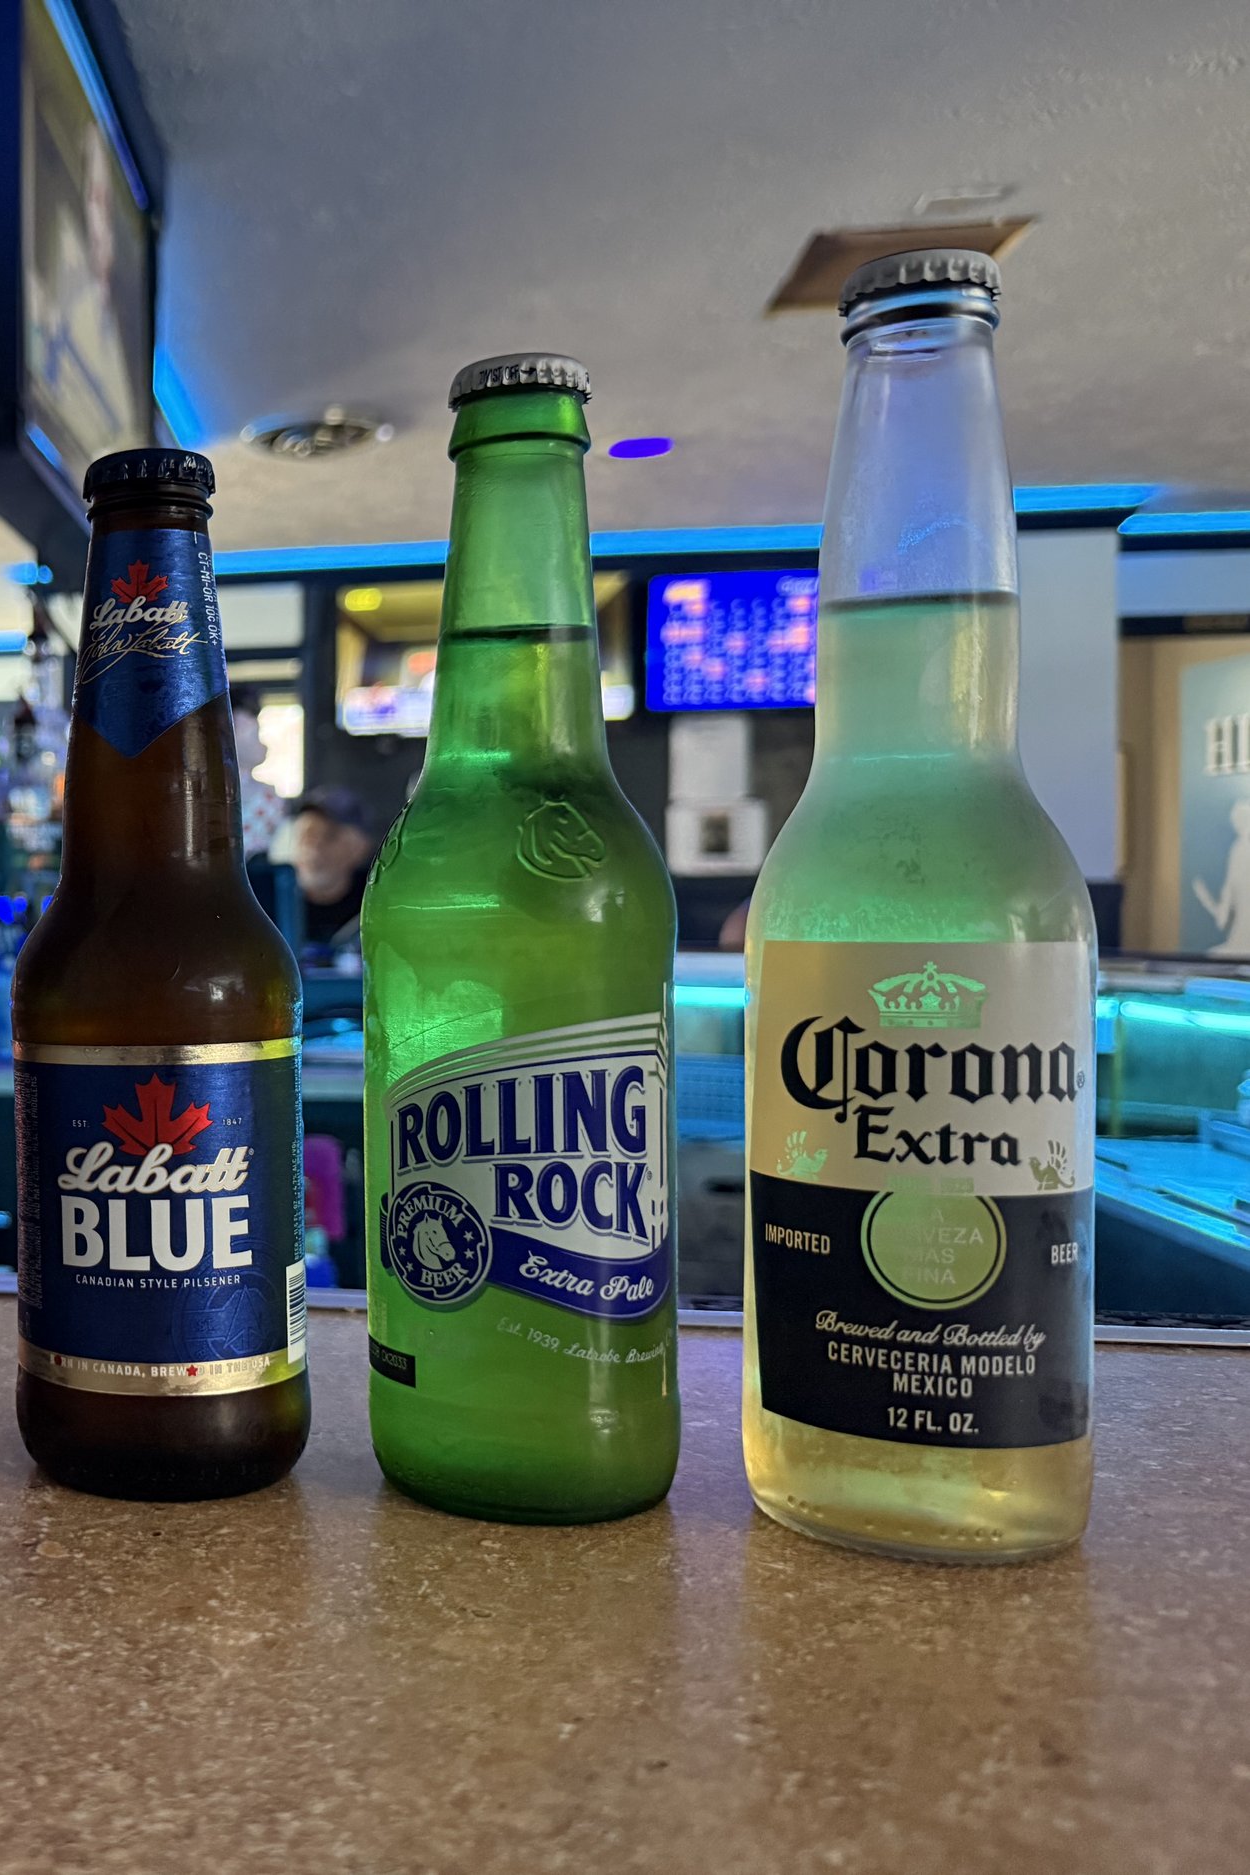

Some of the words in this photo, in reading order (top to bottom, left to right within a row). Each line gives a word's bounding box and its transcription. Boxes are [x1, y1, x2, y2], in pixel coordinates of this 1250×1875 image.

[90, 595, 188, 630] Labatt
[781, 1016, 1078, 1123] Corona
[222, 1118, 242, 1126] 1847
[397, 1065, 646, 1170] ROLLING
[852, 1104, 1022, 1166] Extra
[58, 1142, 249, 1193] Labatt
[396, 1193, 464, 1239] PREMIUM
[492, 1161, 648, 1239] ROCK
[61, 1195, 252, 1272] BLUE
[765, 1223, 831, 1255] IMPORTED
[1051, 1243, 1079, 1265] BEER
[75, 1274, 134, 1288] CANADIAN
[140, 1278, 178, 1288] STYLE
[183, 1274, 240, 1288] PILSENER
[419, 1261, 469, 1287] BEER
[519, 1250, 593, 1296] Extra
[600, 1274, 653, 1302] Pale
[497, 1317, 523, 1337] Est.
[562, 1340, 621, 1363] Latrobe
[816, 1310, 897, 1341] Brewed
[896, 1324, 943, 1345] and
[943, 1323, 1023, 1347] Bottled
[1024, 1324, 1046, 1352] by
[77, 1360, 89, 1371] IN
[93, 1362, 146, 1378] CANADA,
[151, 1364, 205, 1377] BREWD
[210, 1363, 223, 1375] IN
[227, 1360, 250, 1373] THE
[251, 1357, 270, 1370] USA
[828, 1340, 952, 1375] CERVECERIA
[960, 1354, 1037, 1376] MODELO
[893, 1372, 973, 1397] MEXICO
[887, 1406, 908, 1429] 12
[915, 1410, 943, 1433] FL.
[949, 1412, 979, 1434] OZ.
